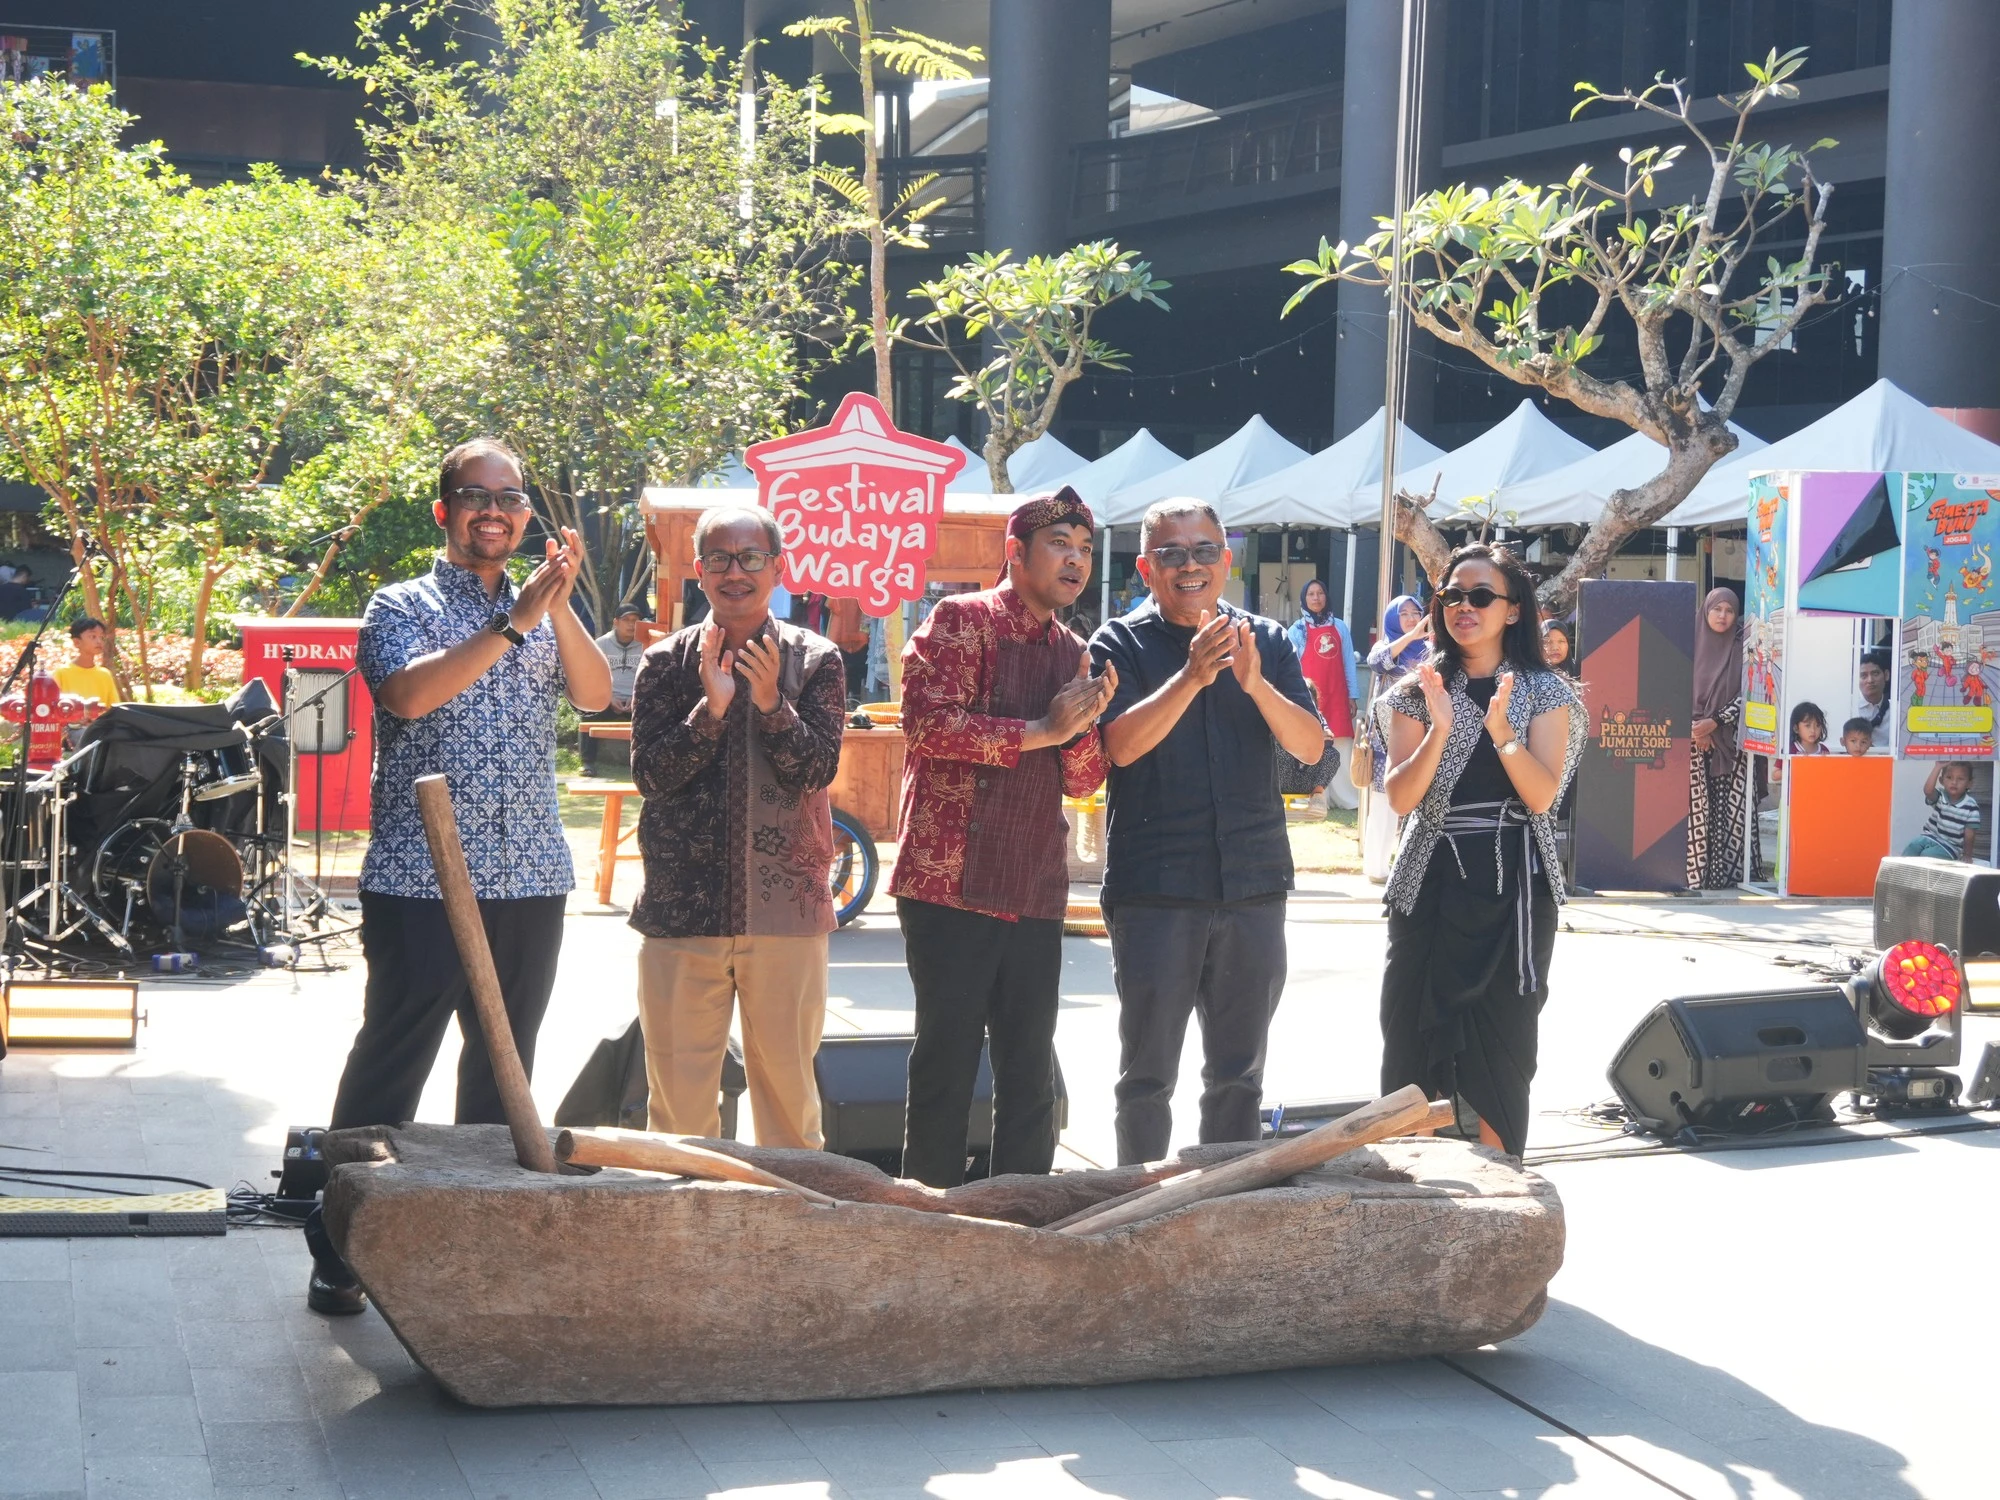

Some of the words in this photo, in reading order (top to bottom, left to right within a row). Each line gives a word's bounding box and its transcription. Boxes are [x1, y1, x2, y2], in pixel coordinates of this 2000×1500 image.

[767, 463, 935, 515] Festival
[1927, 497, 1990, 521] SEMESTA
[1935, 514, 1979, 536] BUKU
[776, 508, 926, 569] Budaya
[1945, 535, 1968, 543] JOGJA
[786, 551, 915, 607] Warga
[263, 643, 358, 660] HDRAN
[30, 723, 60, 732] YDRANT
[1600, 722, 1667, 737] PERAYAAN
[1599, 736, 1641, 748] JUMAT
[1642, 736, 1672, 748] SORE
[1614, 749, 1632, 757] GIK
[1634, 749, 1655, 757] UGM
